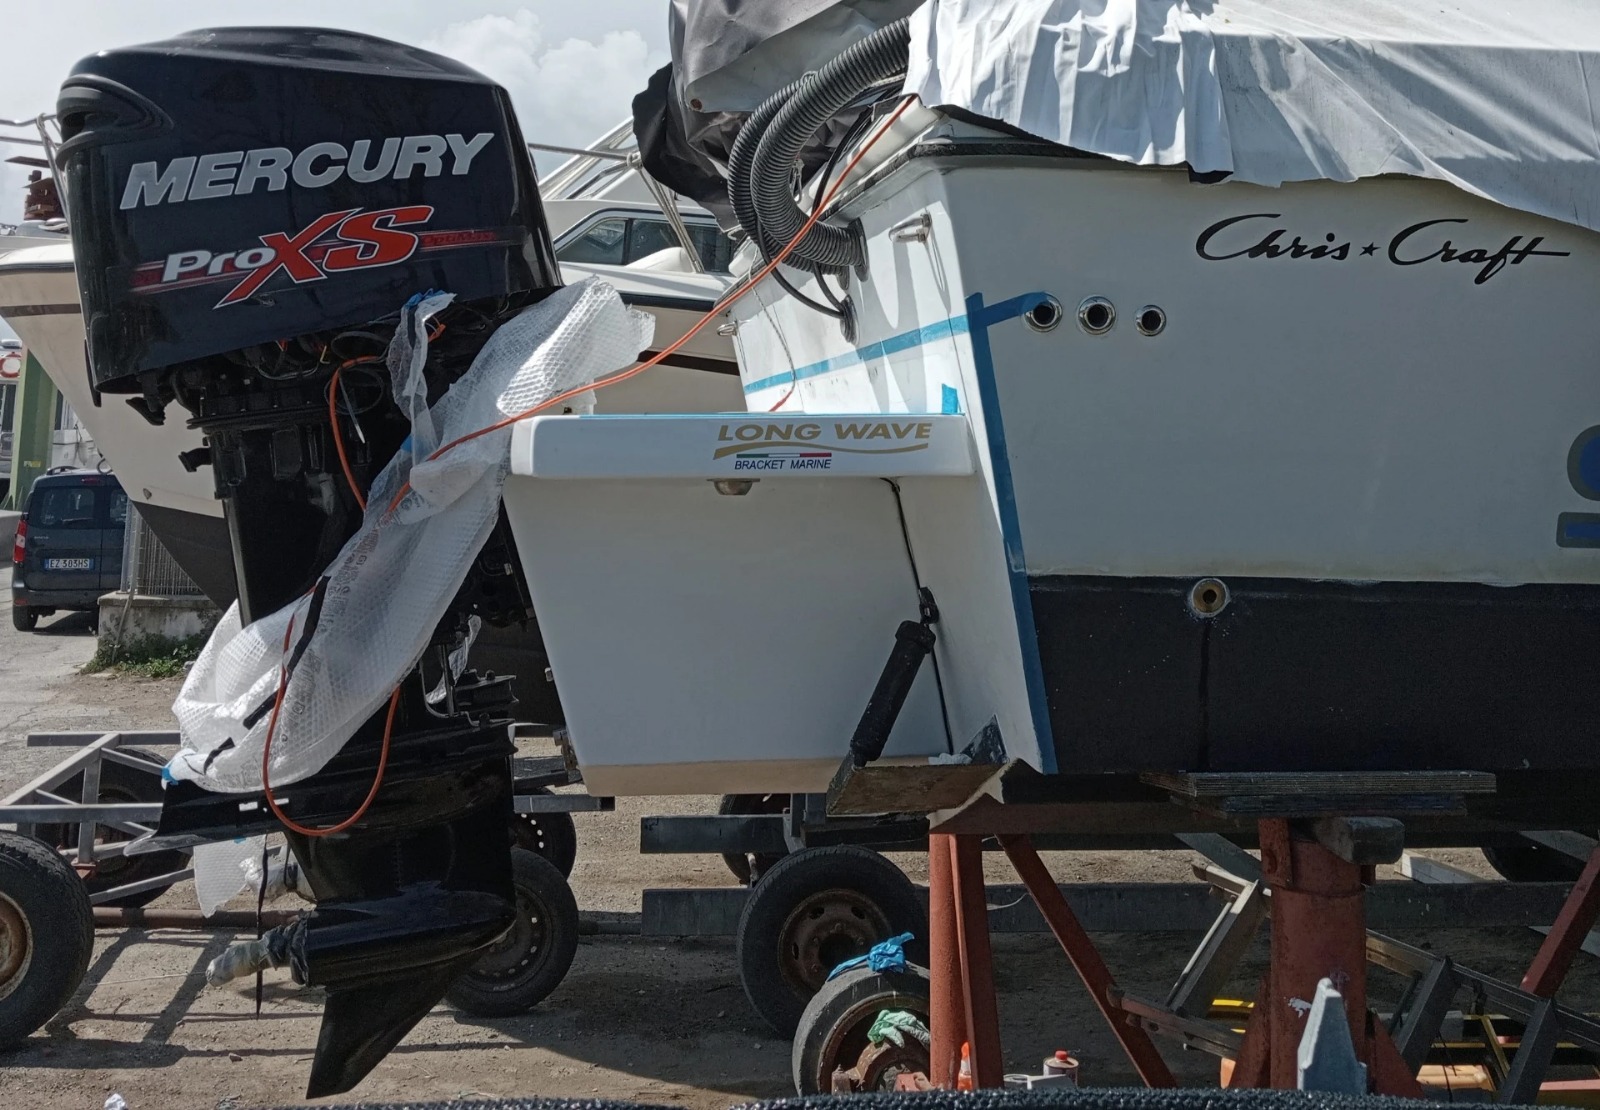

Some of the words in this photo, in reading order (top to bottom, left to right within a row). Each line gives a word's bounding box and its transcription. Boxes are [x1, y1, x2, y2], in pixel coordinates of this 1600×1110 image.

[119, 132, 495, 210] MERCURY
[1195, 213, 1351, 261] Chris
[1387, 218, 1571, 285] Craft
[717, 423, 822, 441] LONG
[834, 422, 933, 440] WAVE
[734, 459, 785, 470] BRACKET
[790, 458, 832, 470] MARINE
